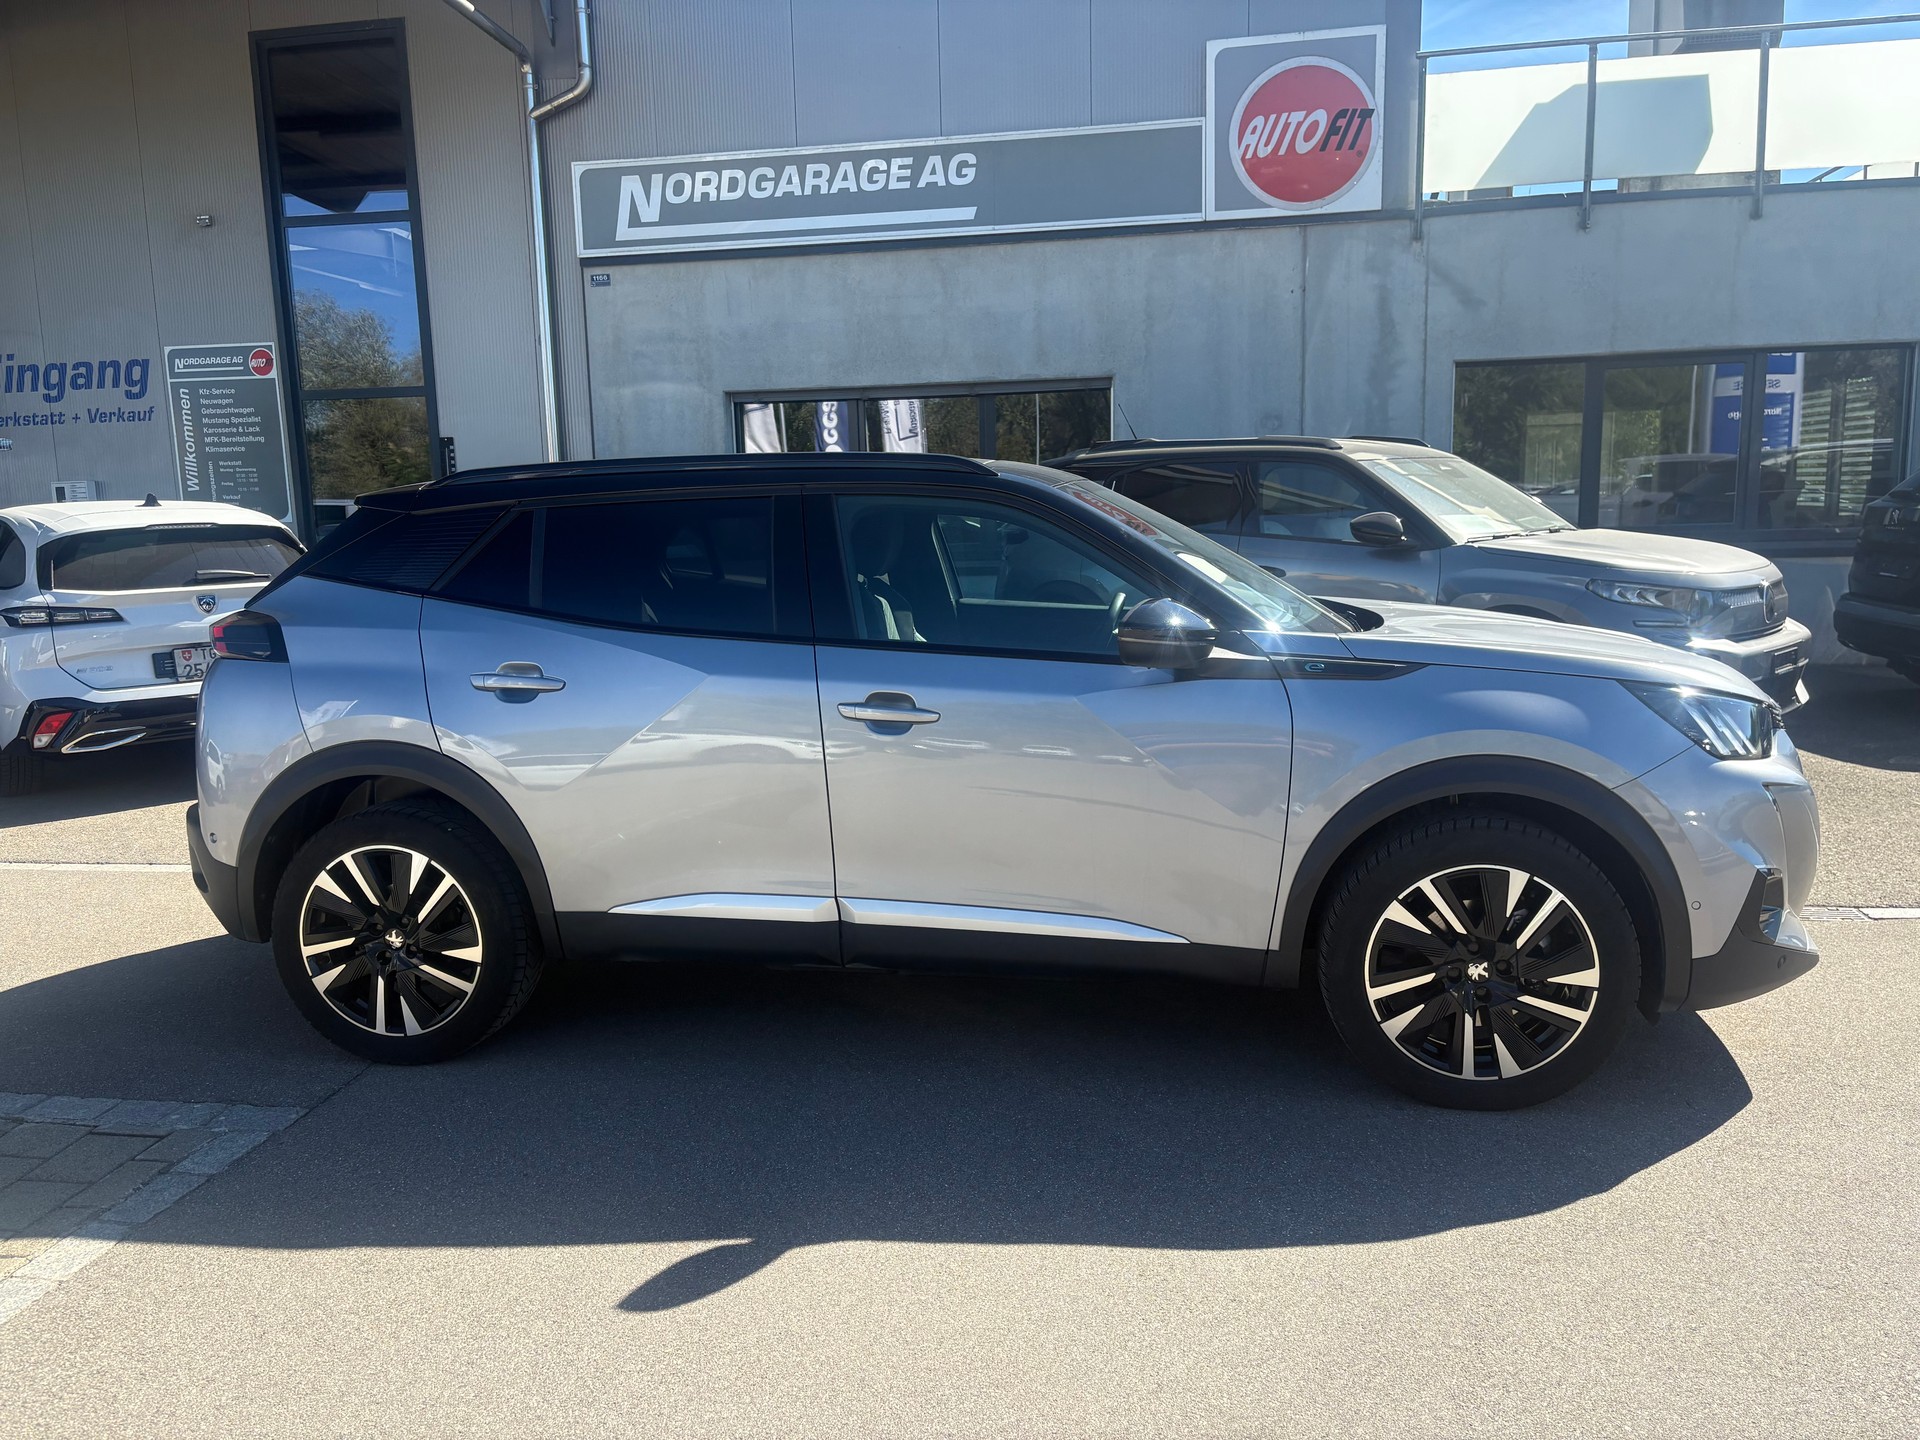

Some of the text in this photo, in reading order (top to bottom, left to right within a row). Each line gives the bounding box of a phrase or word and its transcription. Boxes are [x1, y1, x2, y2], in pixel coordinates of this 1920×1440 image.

[1238, 107, 1375, 160] AUTOFIT
[616, 152, 977, 226] NORDGARAGE AG
[174, 356, 231, 370] NORDGARAGE
[0, 353, 150, 403] ingang
[199, 388, 236, 396] Kfz-Service
[200, 398, 234, 406] Neuwagen
[72, 413, 81, 424] +
[87, 406, 155, 424] Verkauf
[201, 406, 255, 415] Gebrauchtwagen
[180, 388, 200, 491] Willkommen
[200, 648, 217, 660] TG
